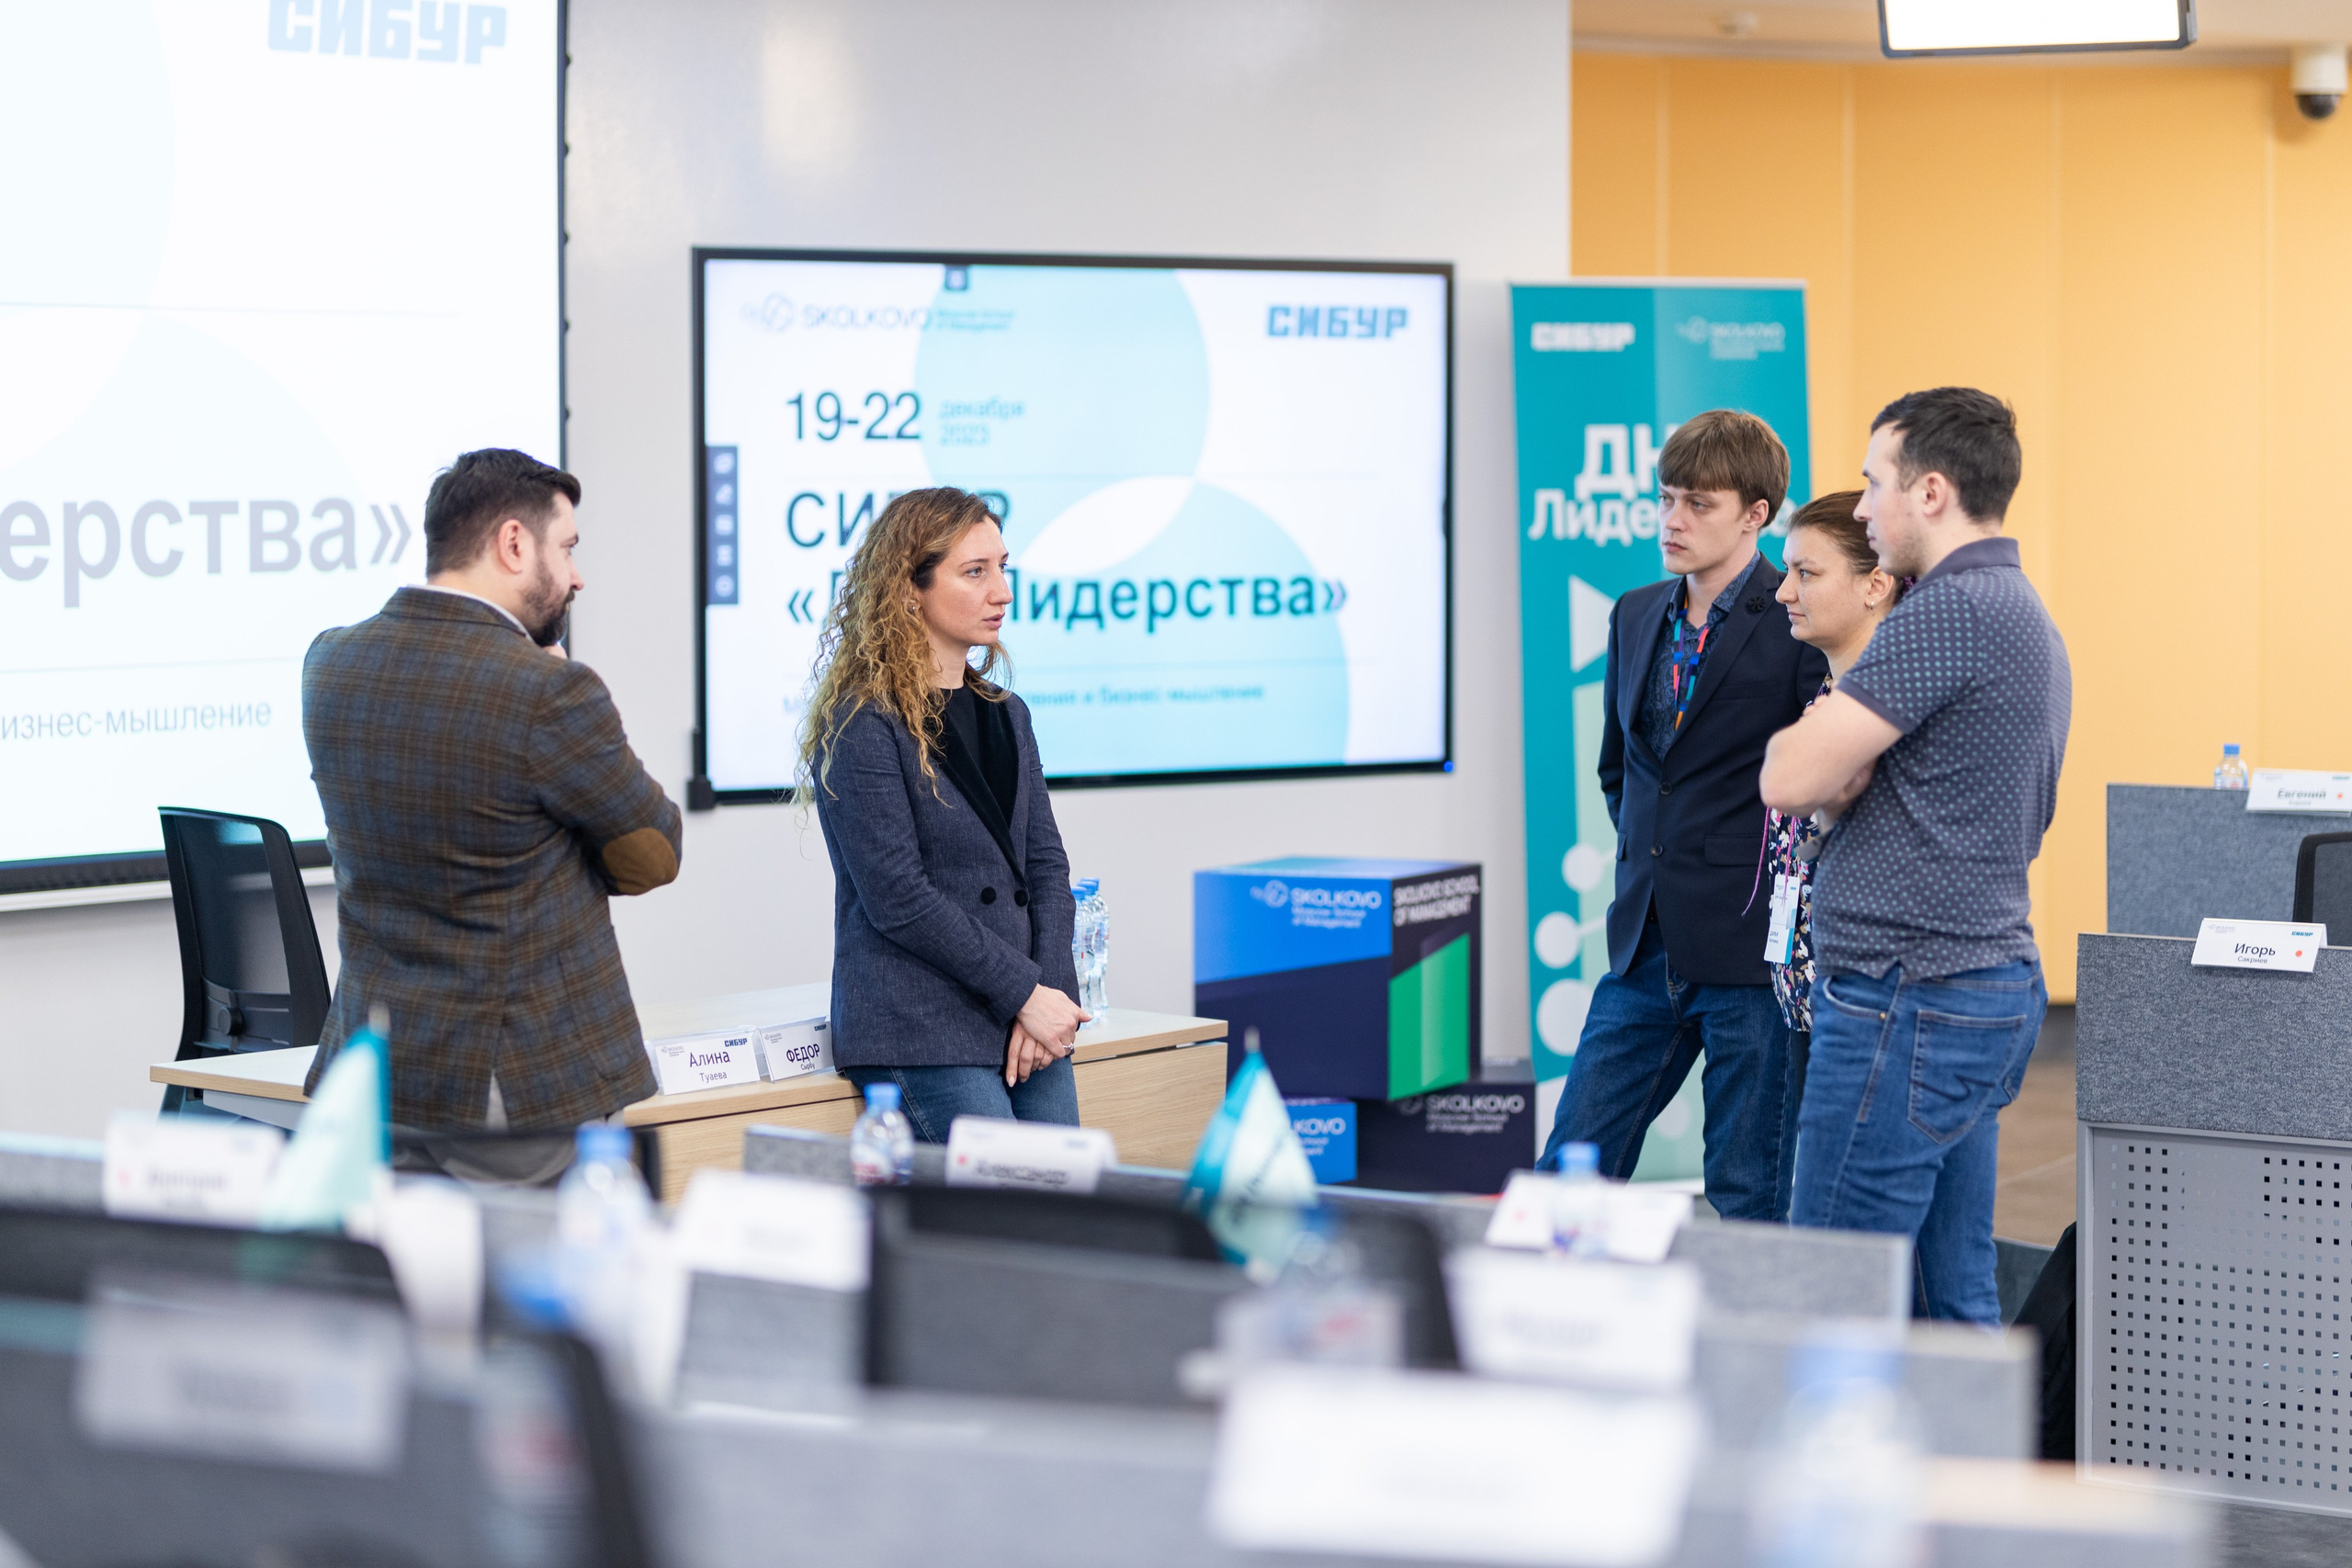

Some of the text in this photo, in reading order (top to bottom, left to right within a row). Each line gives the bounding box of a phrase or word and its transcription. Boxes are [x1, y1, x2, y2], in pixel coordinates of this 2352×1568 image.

[267, 0, 508, 64] СИБУР
[802, 304, 933, 330] SKOLKOVO
[1267, 306, 1408, 339] СИБУР
[786, 391, 922, 441] 19-22
[1574, 423, 1675, 502] ДН
[1291, 887, 1382, 910] SKOLKOVO
[2233, 943, 2276, 958] Игорь
[2237, 955, 2268, 964] Сакриев
[724, 1037, 748, 1048] СИБУР
[689, 1051, 731, 1068] Алина
[786, 1043, 820, 1064] ФЕДОР
[800, 1062, 816, 1072] Сырбу
[699, 1071, 728, 1084] Туаева
[1426, 1094, 1525, 1114] SKOLKOVO
